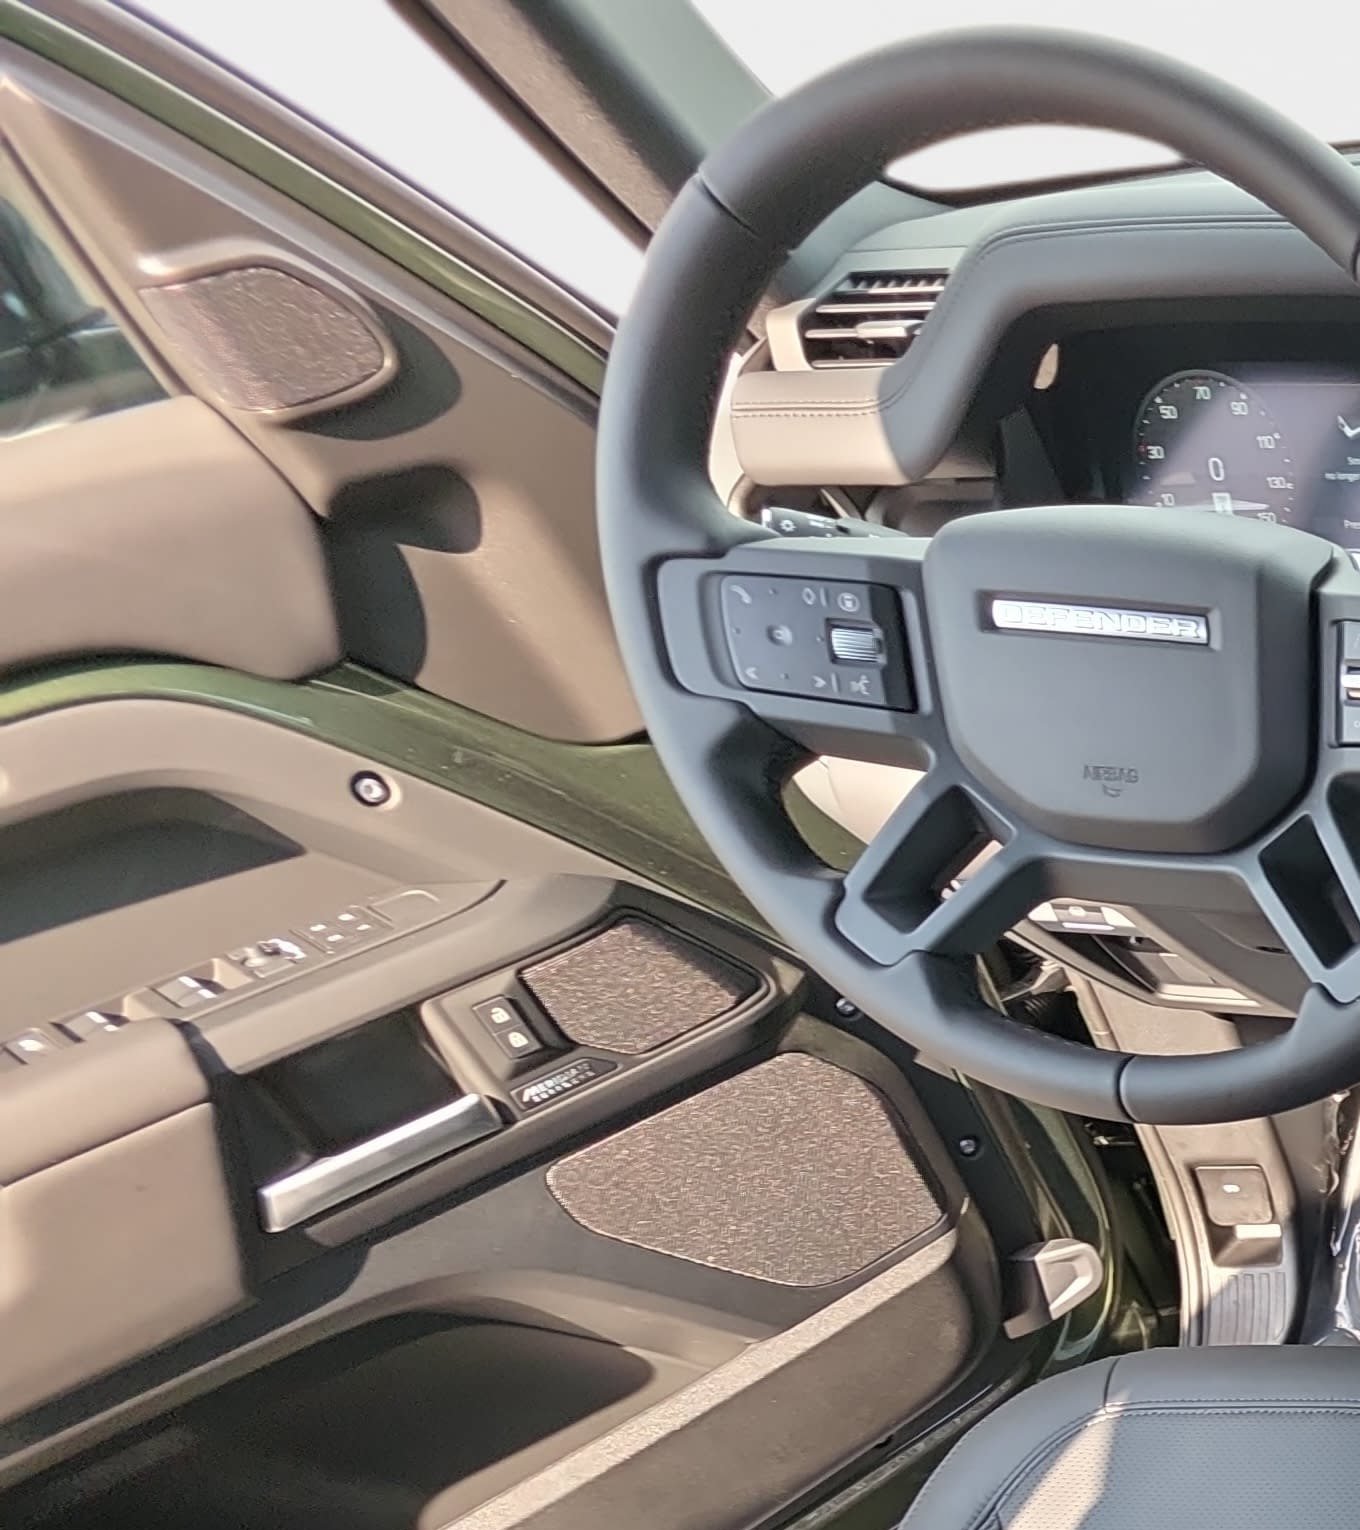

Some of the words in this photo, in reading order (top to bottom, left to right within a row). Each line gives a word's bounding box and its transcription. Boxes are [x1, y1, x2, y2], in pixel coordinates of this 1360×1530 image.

[1193, 386, 1211, 400] 70
[1159, 405, 1178, 419] 50
[1230, 401, 1248, 416] 90
[1256, 434, 1275, 449] 110
[1146, 445, 1165, 459] 30
[1208, 457, 1225, 481] 0
[1266, 476, 1287, 489] 130
[1001, 603, 1201, 639] DEFENDER
